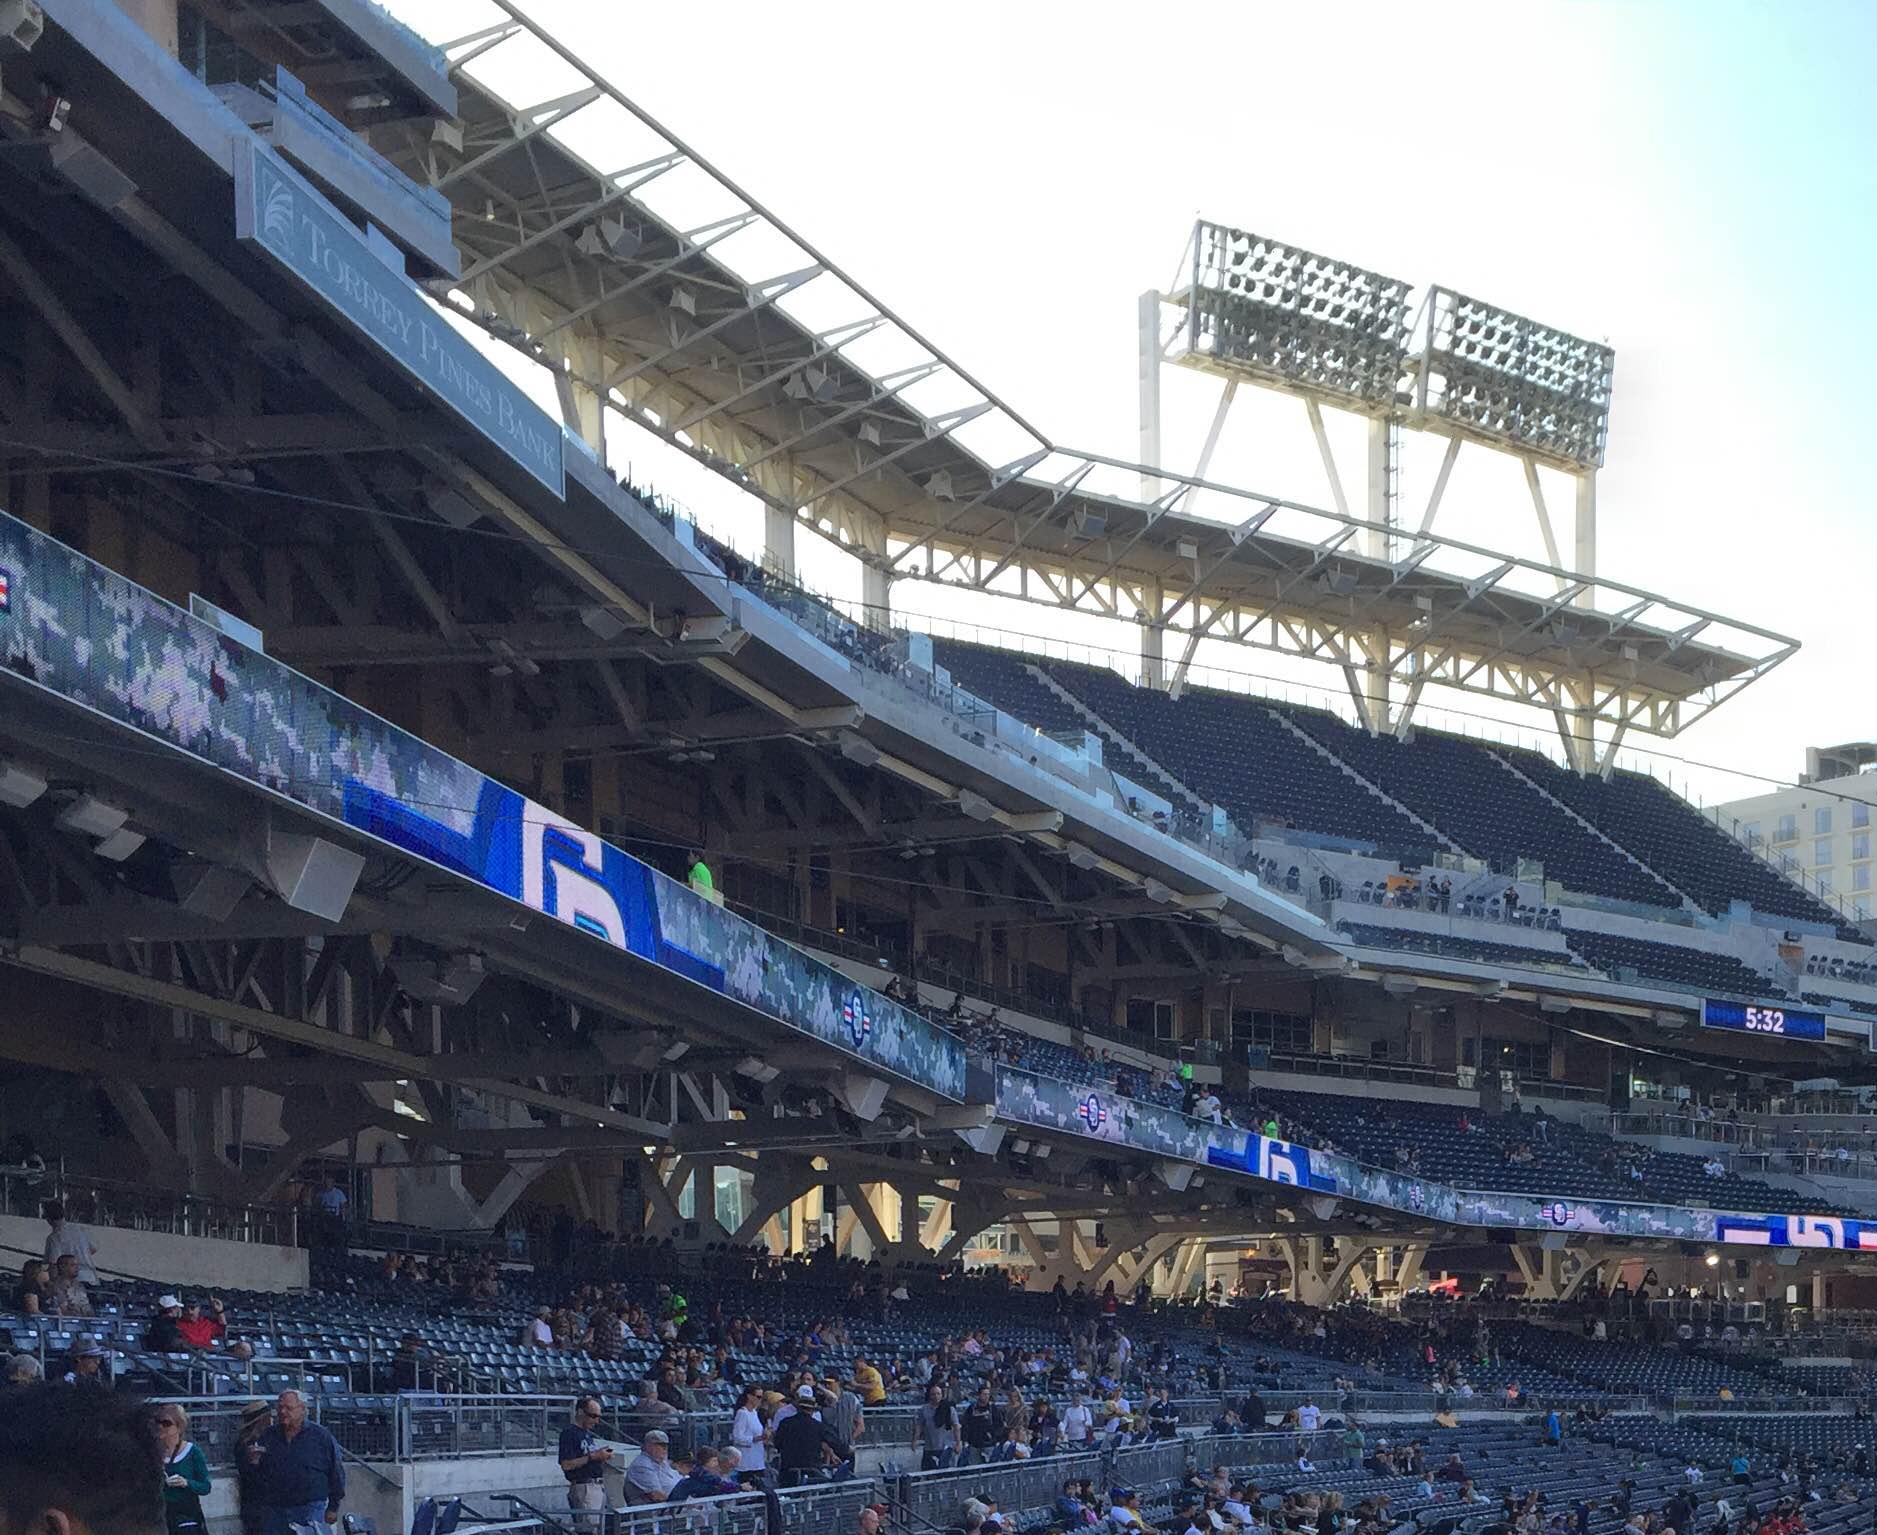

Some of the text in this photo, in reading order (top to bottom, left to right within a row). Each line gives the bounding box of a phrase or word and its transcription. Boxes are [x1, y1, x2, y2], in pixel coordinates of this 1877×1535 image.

[419, 316, 495, 415] PINES
[497, 390, 558, 471] BANK
[1745, 1008, 1785, 1035] 5:32
